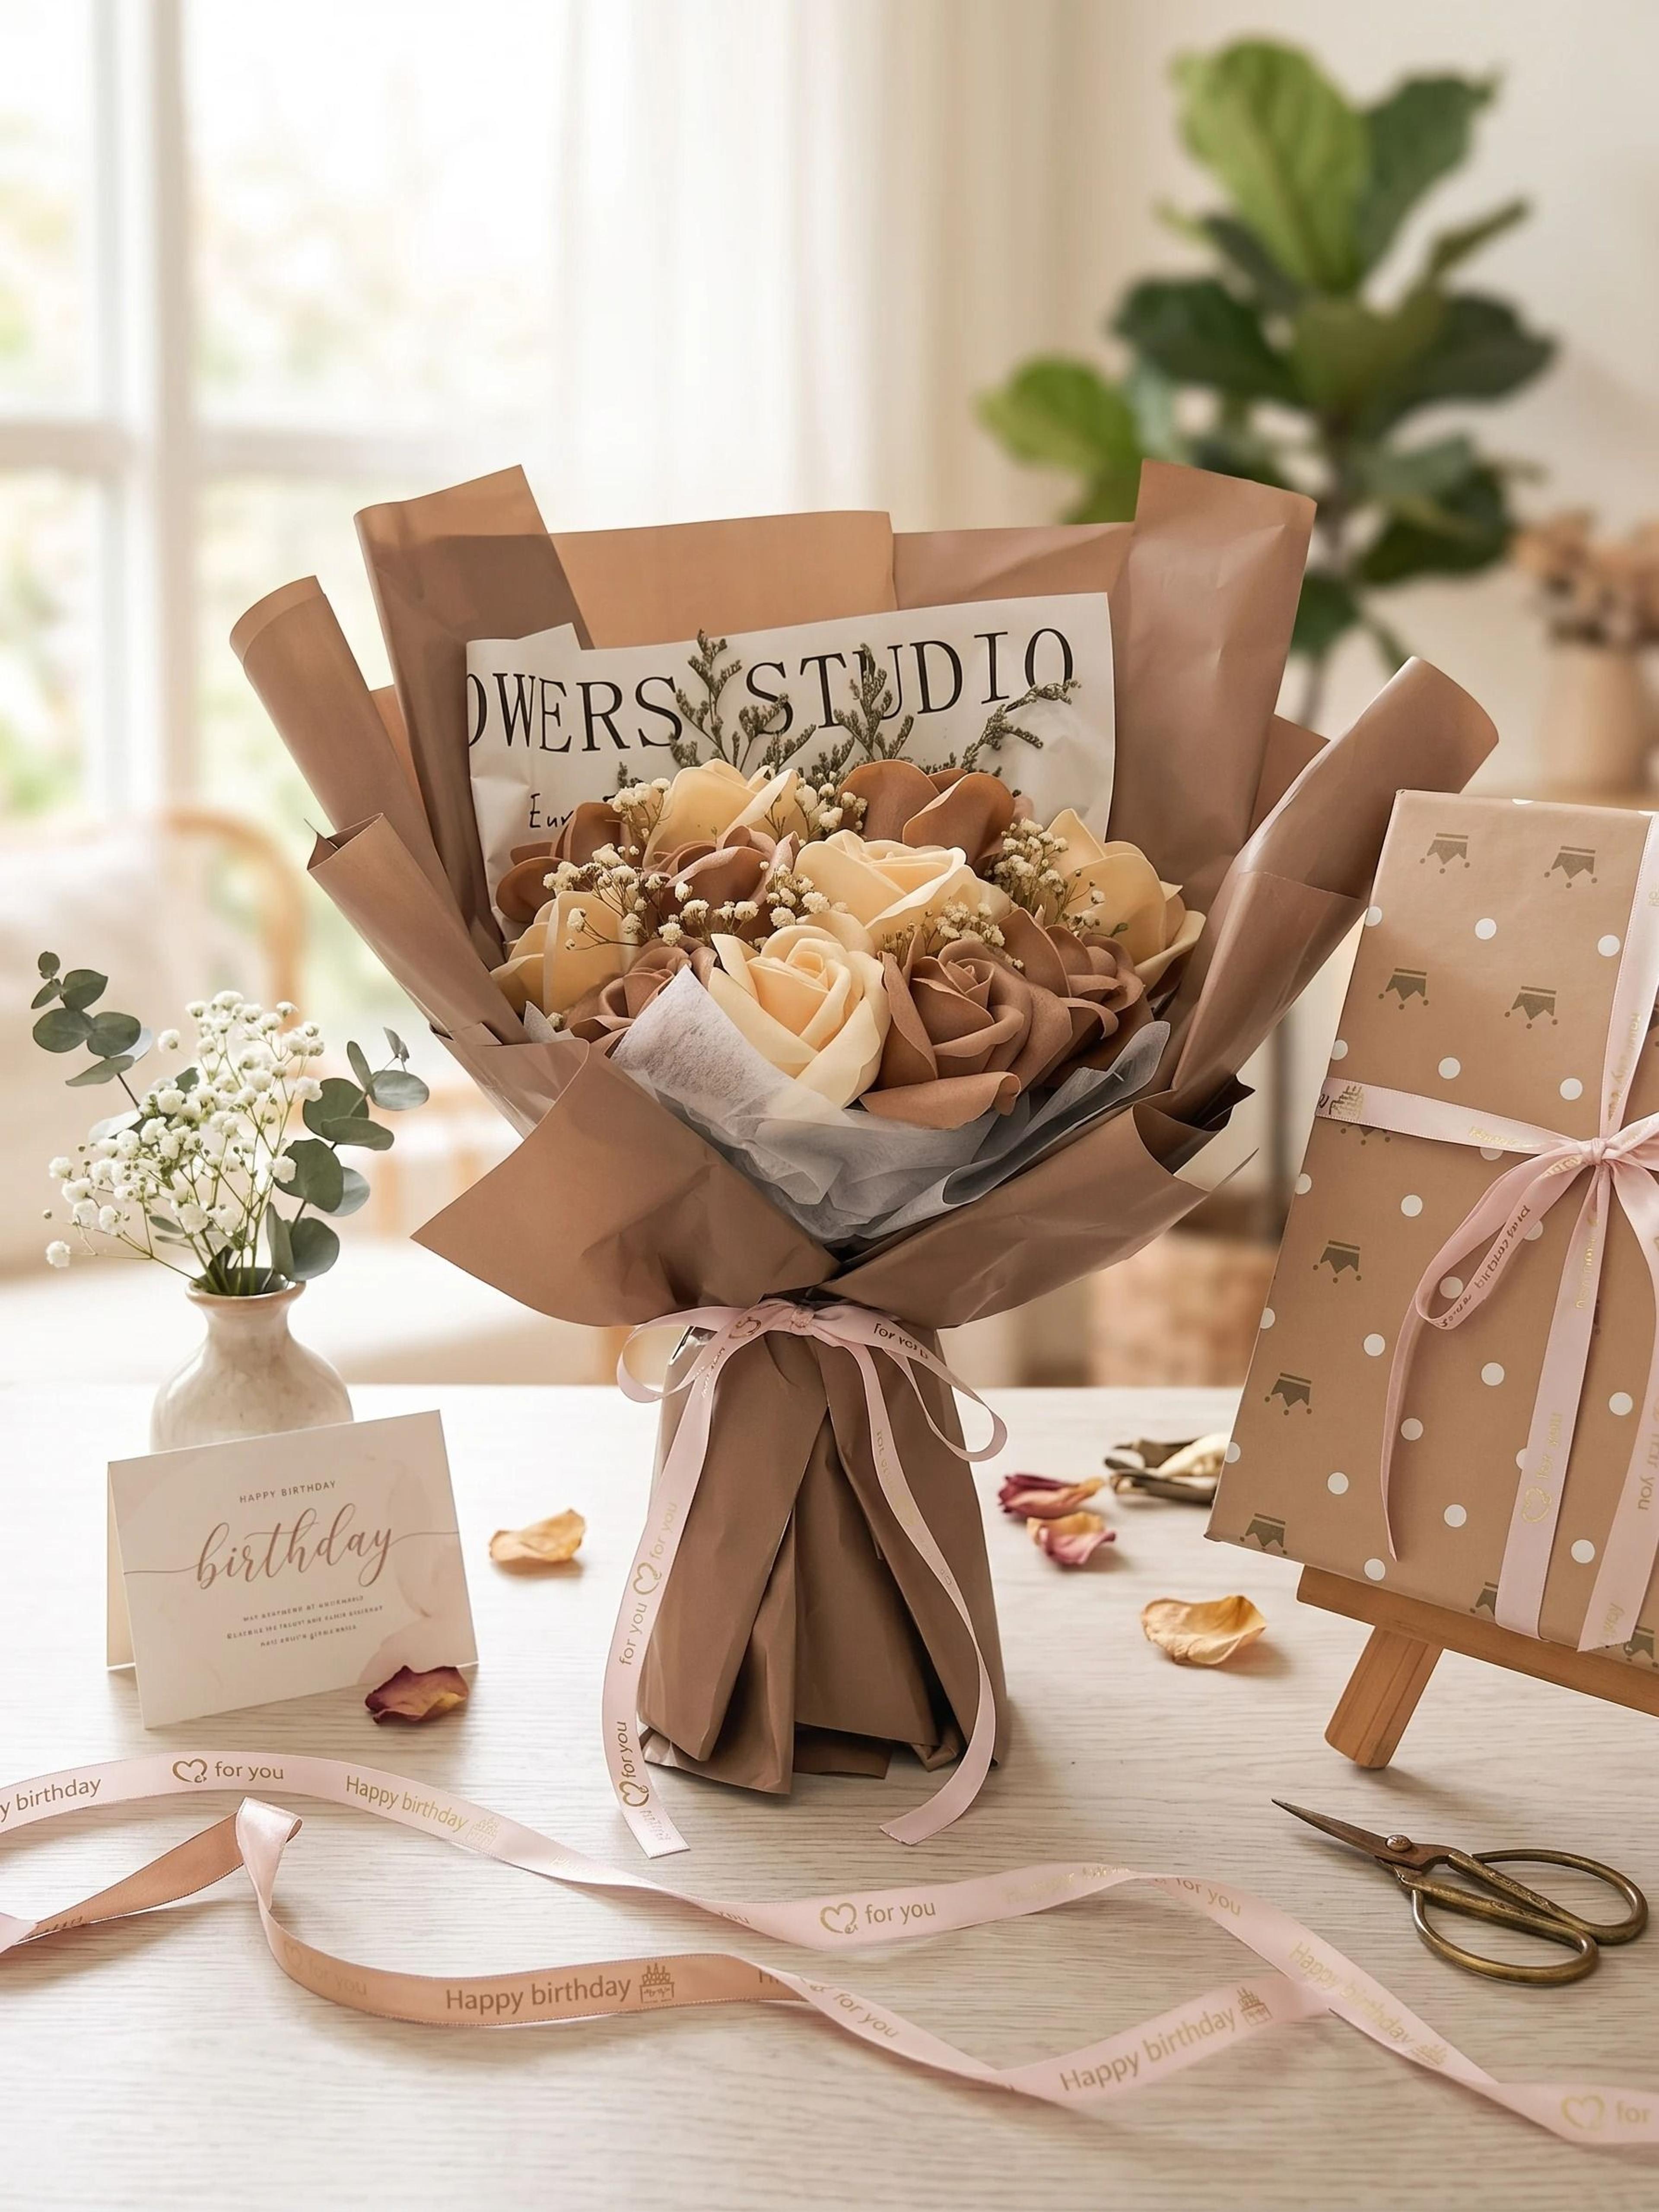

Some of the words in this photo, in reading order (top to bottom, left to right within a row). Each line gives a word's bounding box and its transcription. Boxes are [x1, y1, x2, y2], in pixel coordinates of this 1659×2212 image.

[745, 628, 1074, 736] STUDIO
[239, 1490, 276, 1504] HAPPY
[281, 1480, 337, 1497] BIRTHDAY
[1637, 1476, 1655, 1510] you
[190, 1502, 395, 1590] birthday
[649, 1537, 666, 1560] for
[661, 1502, 678, 1532] you
[619, 1638, 636, 1666] for
[629, 1602, 648, 1634] you
[617, 1721, 633, 1753] you
[215, 1761, 243, 1777] for
[248, 1766, 284, 1782] you
[622, 1756, 636, 1778] for
[16, 1778, 102, 1811] birthday
[346, 1775, 399, 1810] Happy
[402, 1791, 468, 1833] birthday
[865, 1904, 894, 1924] for
[899, 1902, 936, 1925] you
[1208, 1888, 1241, 1917] you
[446, 1989, 524, 2015] Happy
[531, 1975, 631, 2006] birthday
[1288, 1942, 1340, 1990] Happy
[1340, 1979, 1416, 2044] birthday
[833, 1993, 864, 2012] for
[857, 2013, 899, 2038] you
[1060, 2051, 1139, 2091] Happy
[1142, 2008, 1236, 2063] birthday
